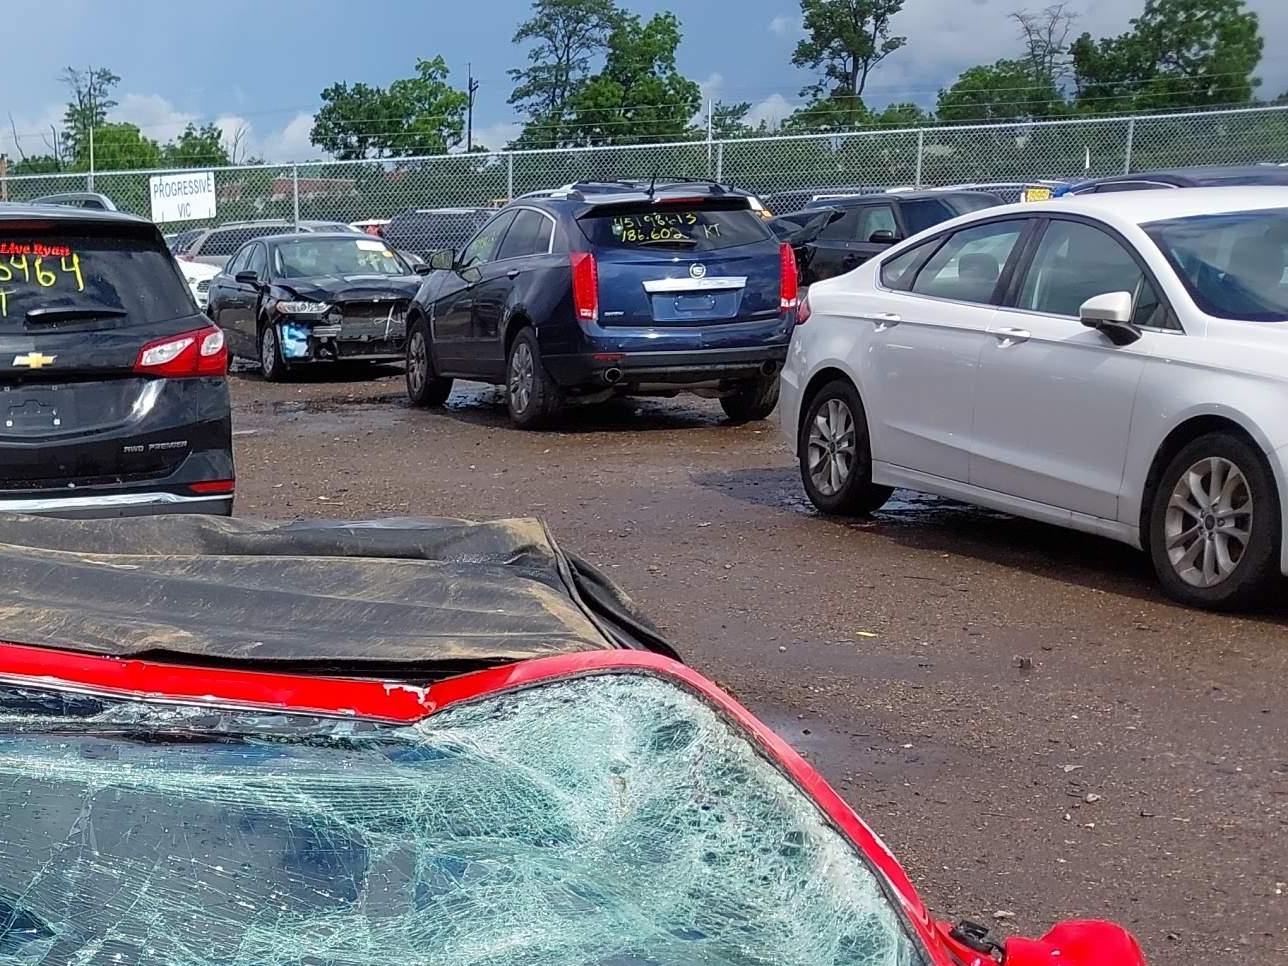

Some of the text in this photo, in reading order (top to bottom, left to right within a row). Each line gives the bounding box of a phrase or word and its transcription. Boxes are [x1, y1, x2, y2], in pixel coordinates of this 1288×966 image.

[153, 178, 212, 200] PROGRESSIVE
[177, 202, 191, 219] VIC
[703, 223, 722, 239] KT
[1, 242, 25, 254] Live
[33, 243, 71, 256] Ryan
